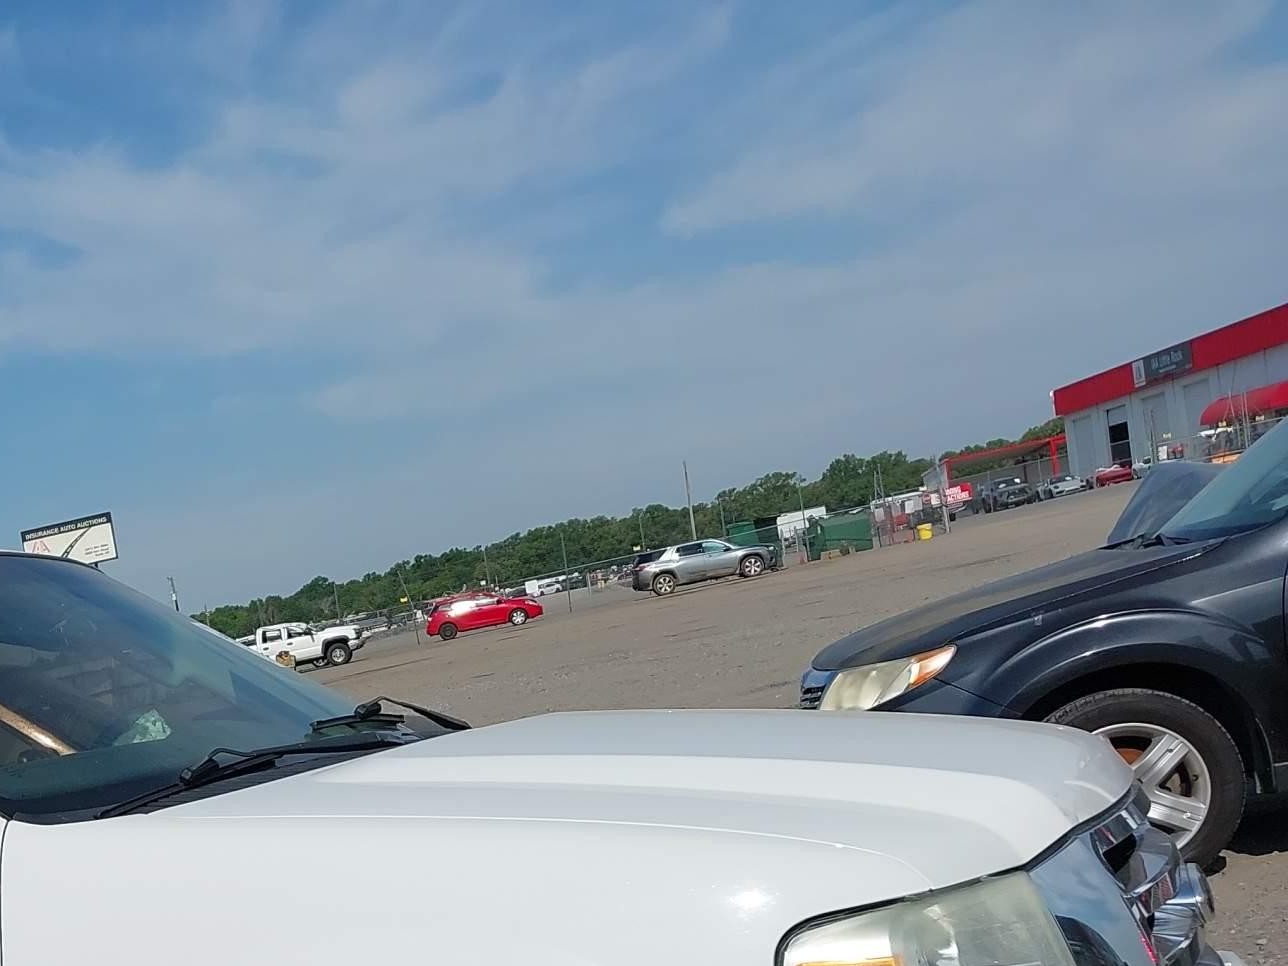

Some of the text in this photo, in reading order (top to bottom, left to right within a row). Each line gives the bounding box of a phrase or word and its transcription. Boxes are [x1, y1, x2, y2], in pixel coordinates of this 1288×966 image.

[25, 516, 107, 540] INSURANCE AUTO AUCTIONS
